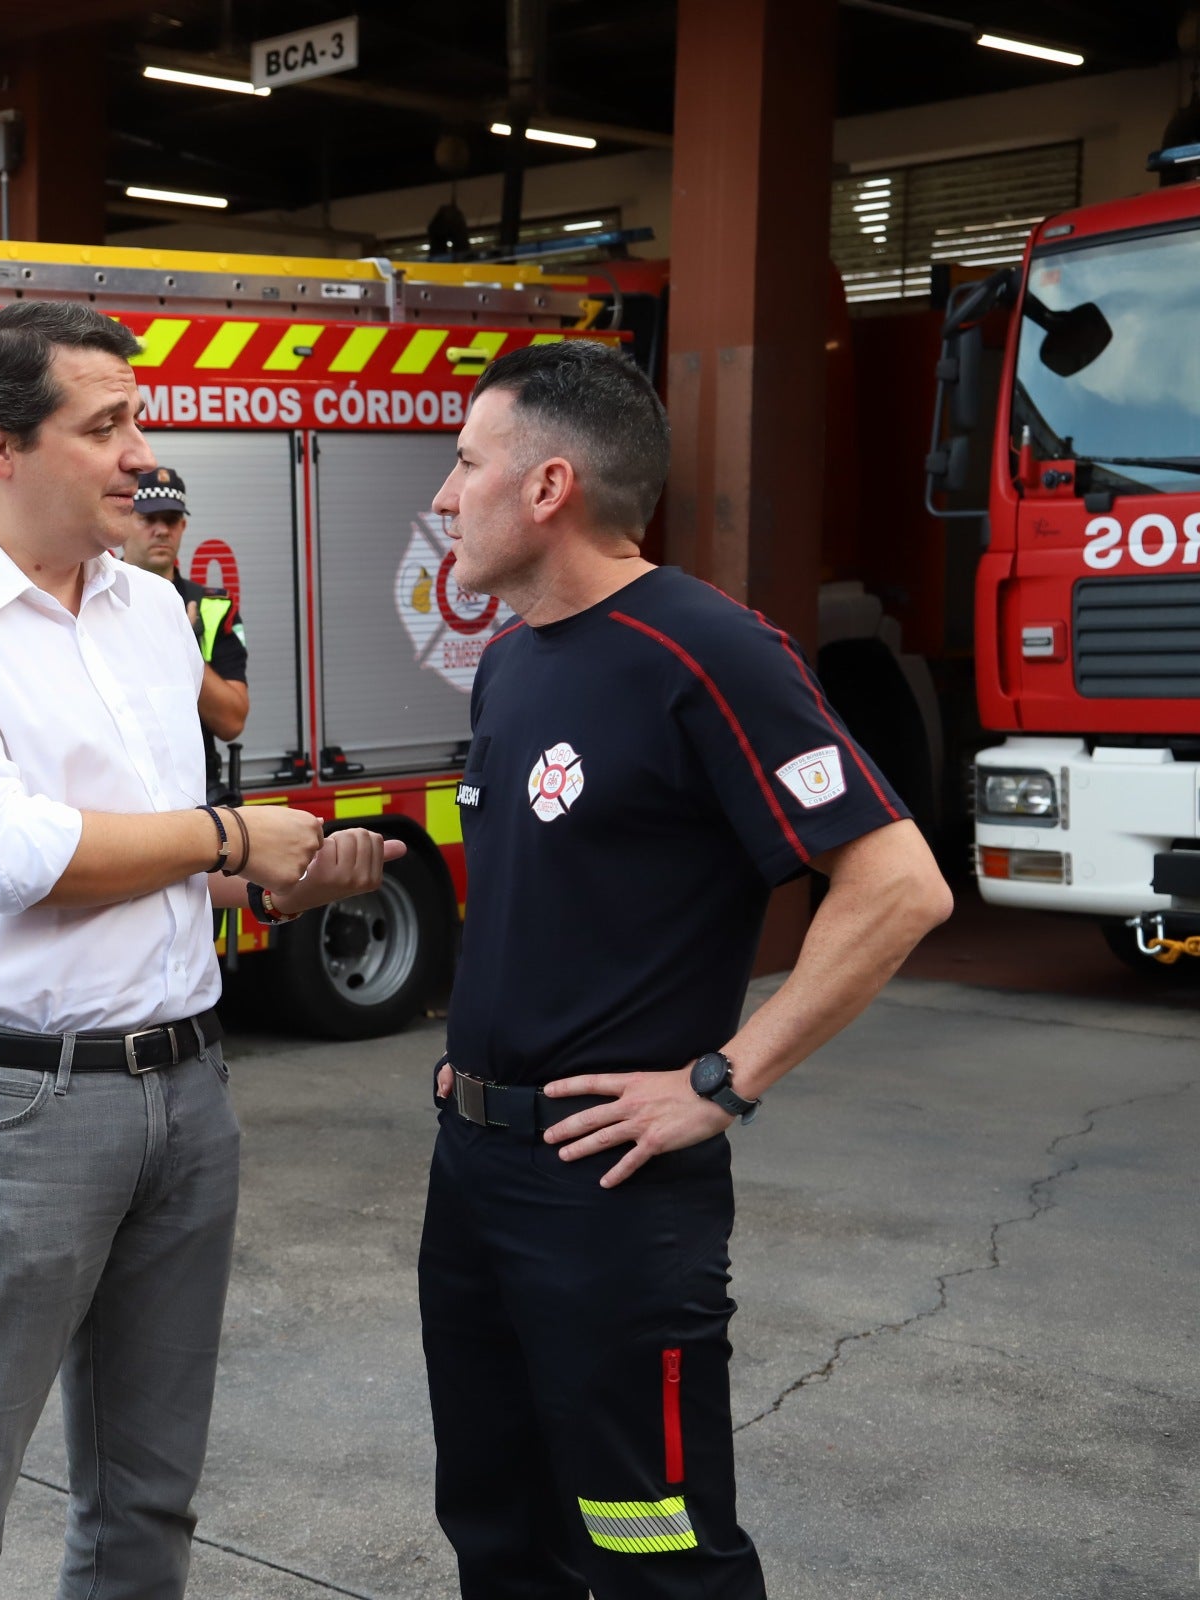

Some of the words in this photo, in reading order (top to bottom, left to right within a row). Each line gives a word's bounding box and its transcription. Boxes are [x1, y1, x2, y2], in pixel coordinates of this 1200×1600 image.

[266, 32, 344, 76] BCA-3
[137, 384, 302, 424] MBEROS
[550, 748, 571, 763] 080
